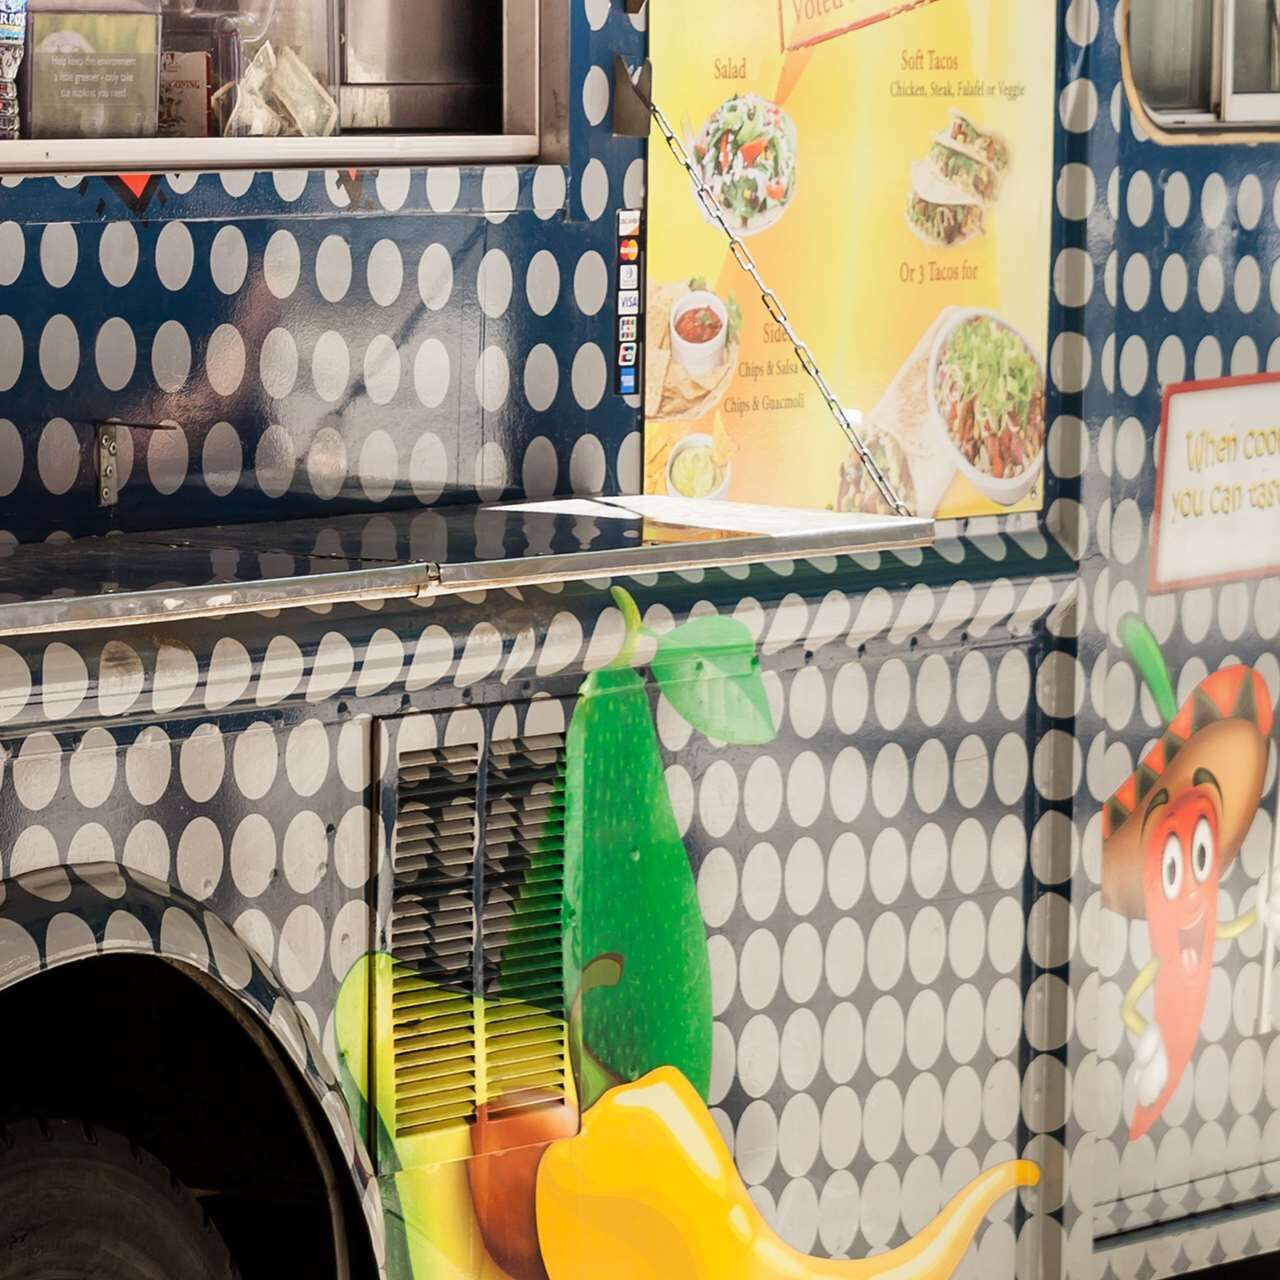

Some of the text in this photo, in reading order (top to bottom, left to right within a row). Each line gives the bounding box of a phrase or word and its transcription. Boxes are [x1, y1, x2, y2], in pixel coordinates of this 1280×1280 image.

[713, 56, 747, 80] Salad
[900, 48, 959, 71] Soft Tacos
[987, 84, 996, 97] or
[998, 80, 1025, 102] Veggie
[900, 258, 978, 285] Or 3 Tacos for
[762, 322, 789, 344] Side
[739, 359, 798, 382] Chips & Salsa
[724, 396, 750, 417] Chips
[752, 396, 760, 412] &
[1186, 428, 1238, 472] When
[1172, 487, 1203, 524] you
[1210, 482, 1242, 515] can
